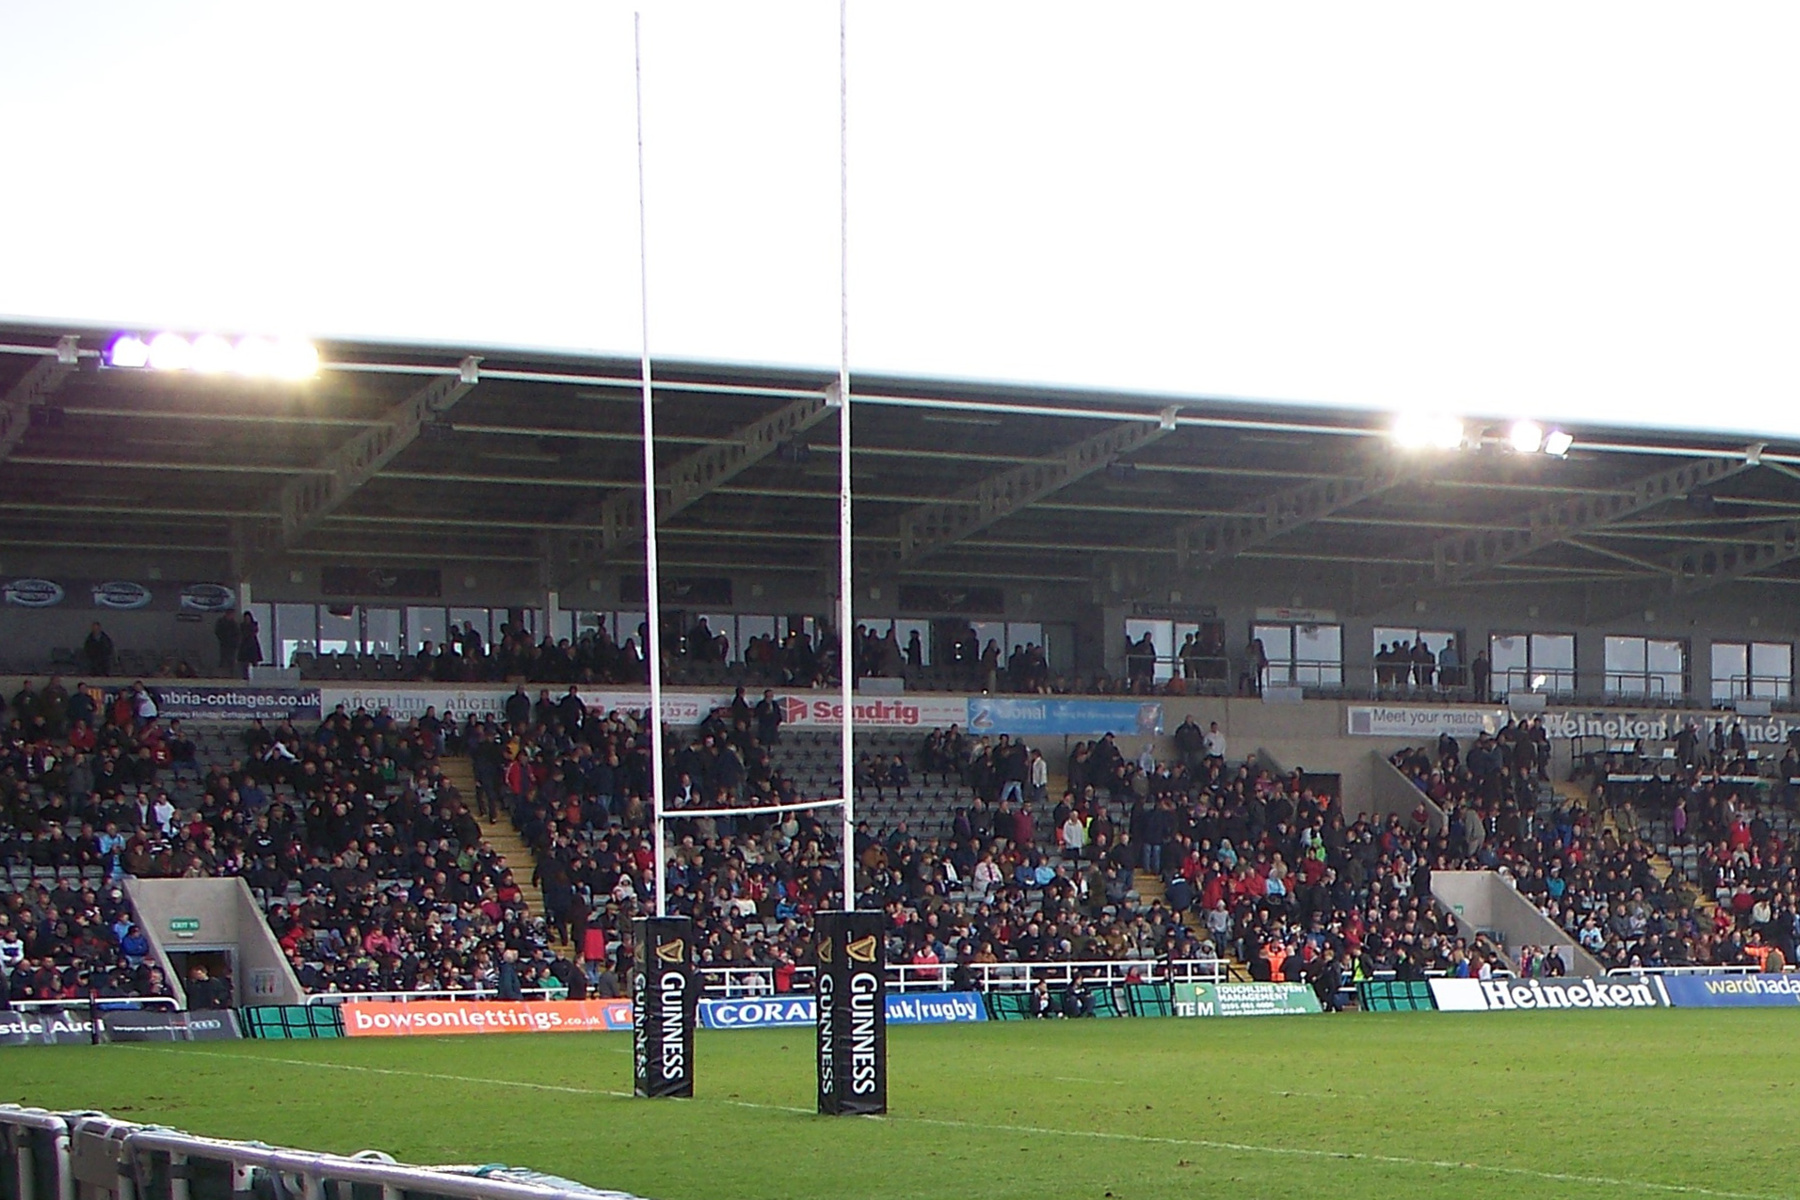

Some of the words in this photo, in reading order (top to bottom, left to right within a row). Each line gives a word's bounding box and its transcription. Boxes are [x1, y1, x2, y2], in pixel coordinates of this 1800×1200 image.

[813, 701, 919, 725] Sendrig
[1373, 709, 1406, 723] Meet
[1410, 712, 1438, 726] your
[1544, 714, 1665, 740] Heineken
[1481, 976, 1656, 1010] Heineken
[355, 1009, 600, 1029] bowsonlettings.co.uk
[633, 972, 647, 1079] GUINNESS
[660, 972, 686, 1080] GUINNESS
[819, 973, 835, 1095] GUINNESS
[851, 972, 878, 1095] GUINNESS
